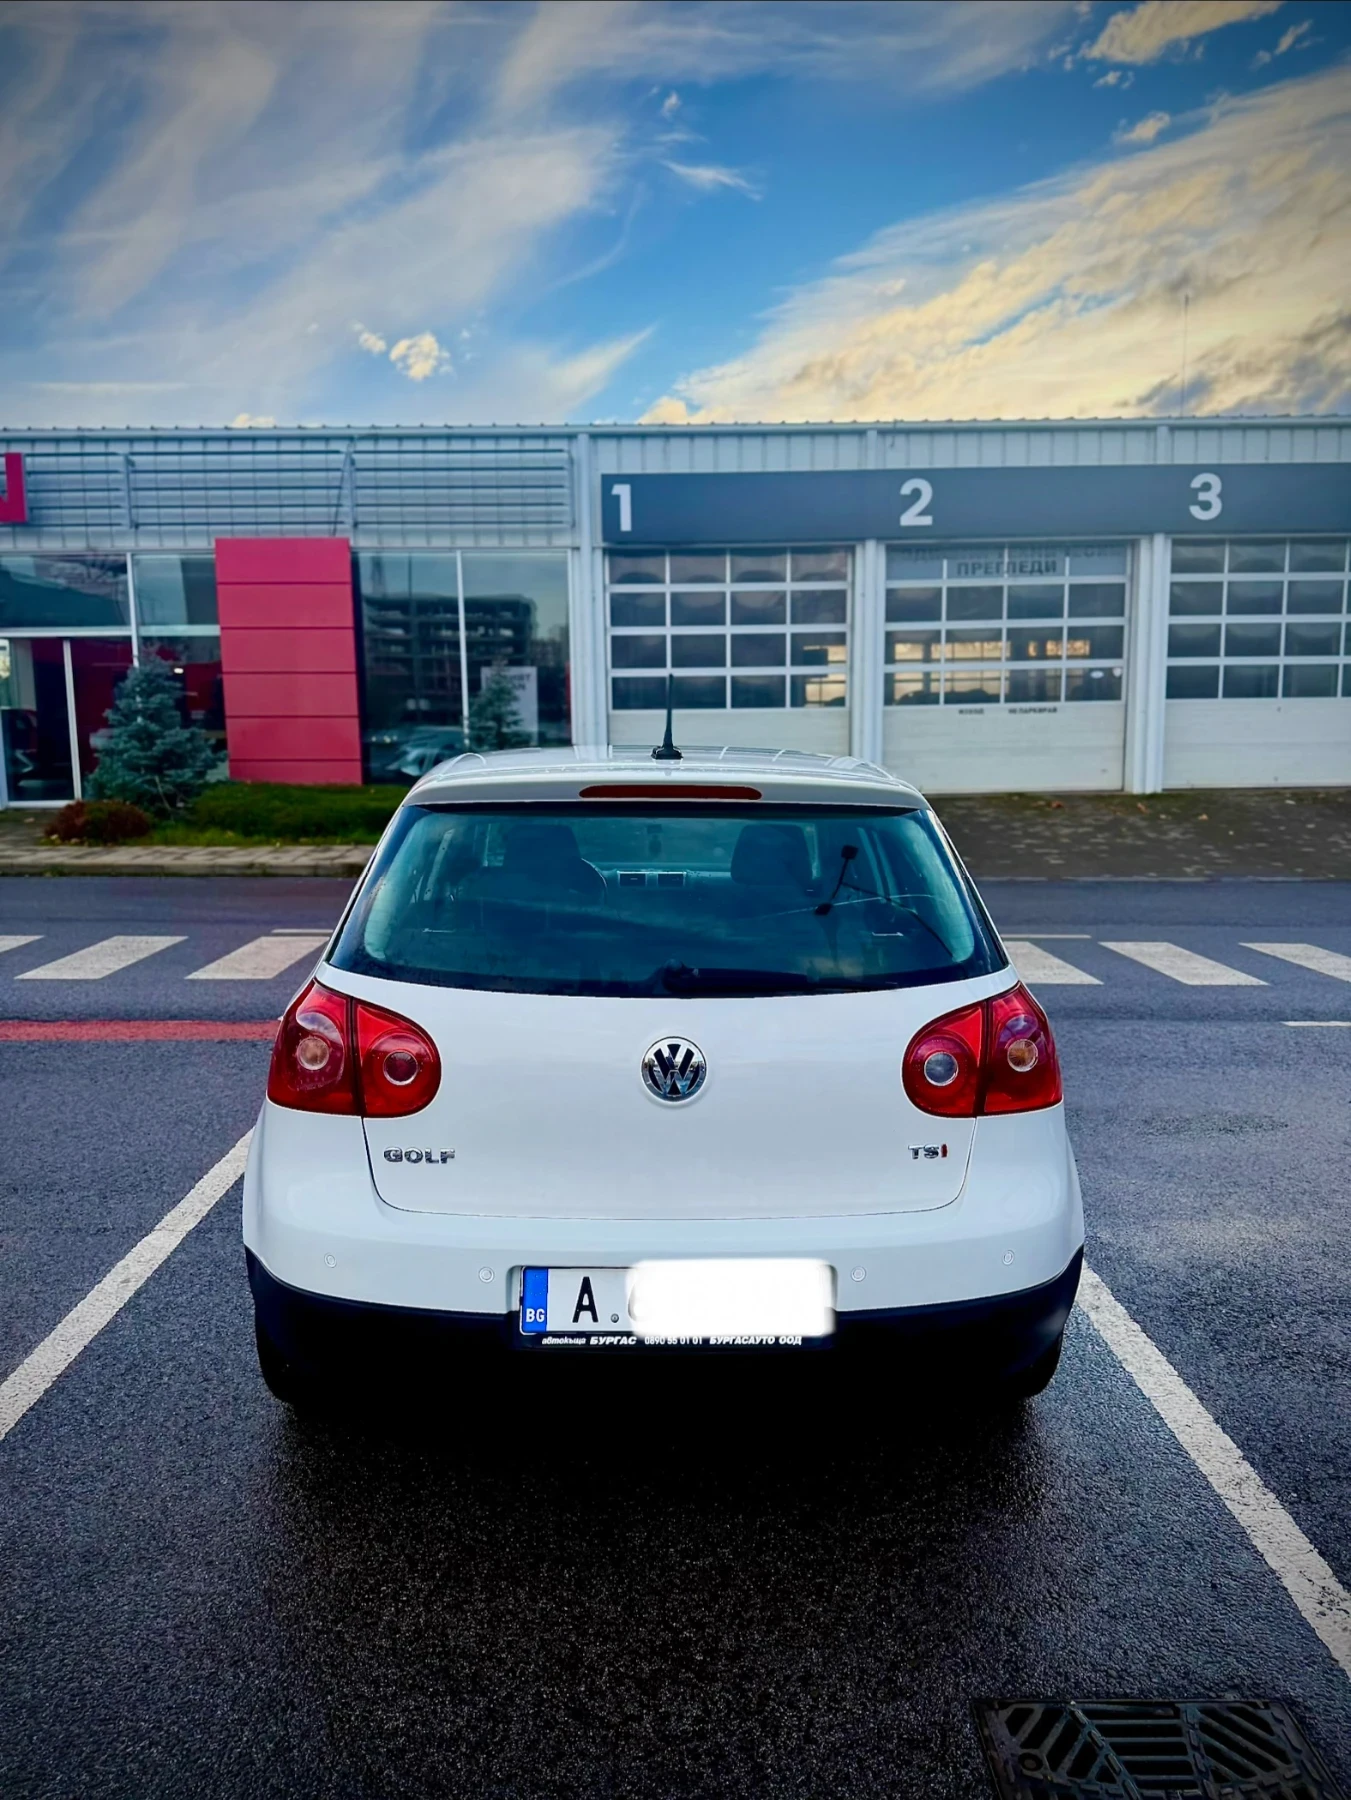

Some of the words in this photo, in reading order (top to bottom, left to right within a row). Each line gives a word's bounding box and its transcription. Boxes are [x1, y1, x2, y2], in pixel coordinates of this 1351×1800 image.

[611, 484, 632, 531] 1
[900, 478, 934, 526] 2
[1189, 472, 1222, 521] 3
[957, 560, 1057, 576] ПРЕГЛЕДИ
[643, 1038, 704, 1100] VW
[383, 1147, 455, 1164] GOLF
[908, 1143, 948, 1160] TSI
[525, 1308, 545, 1322] BG
[571, 1276, 599, 1323] A
[590, 1336, 637, 1345] БУРГАС
[680, 1336, 689, 1345] 01
[709, 1336, 775, 1345] БУРГАСАУТО
[778, 1336, 802, 1345] ООД
